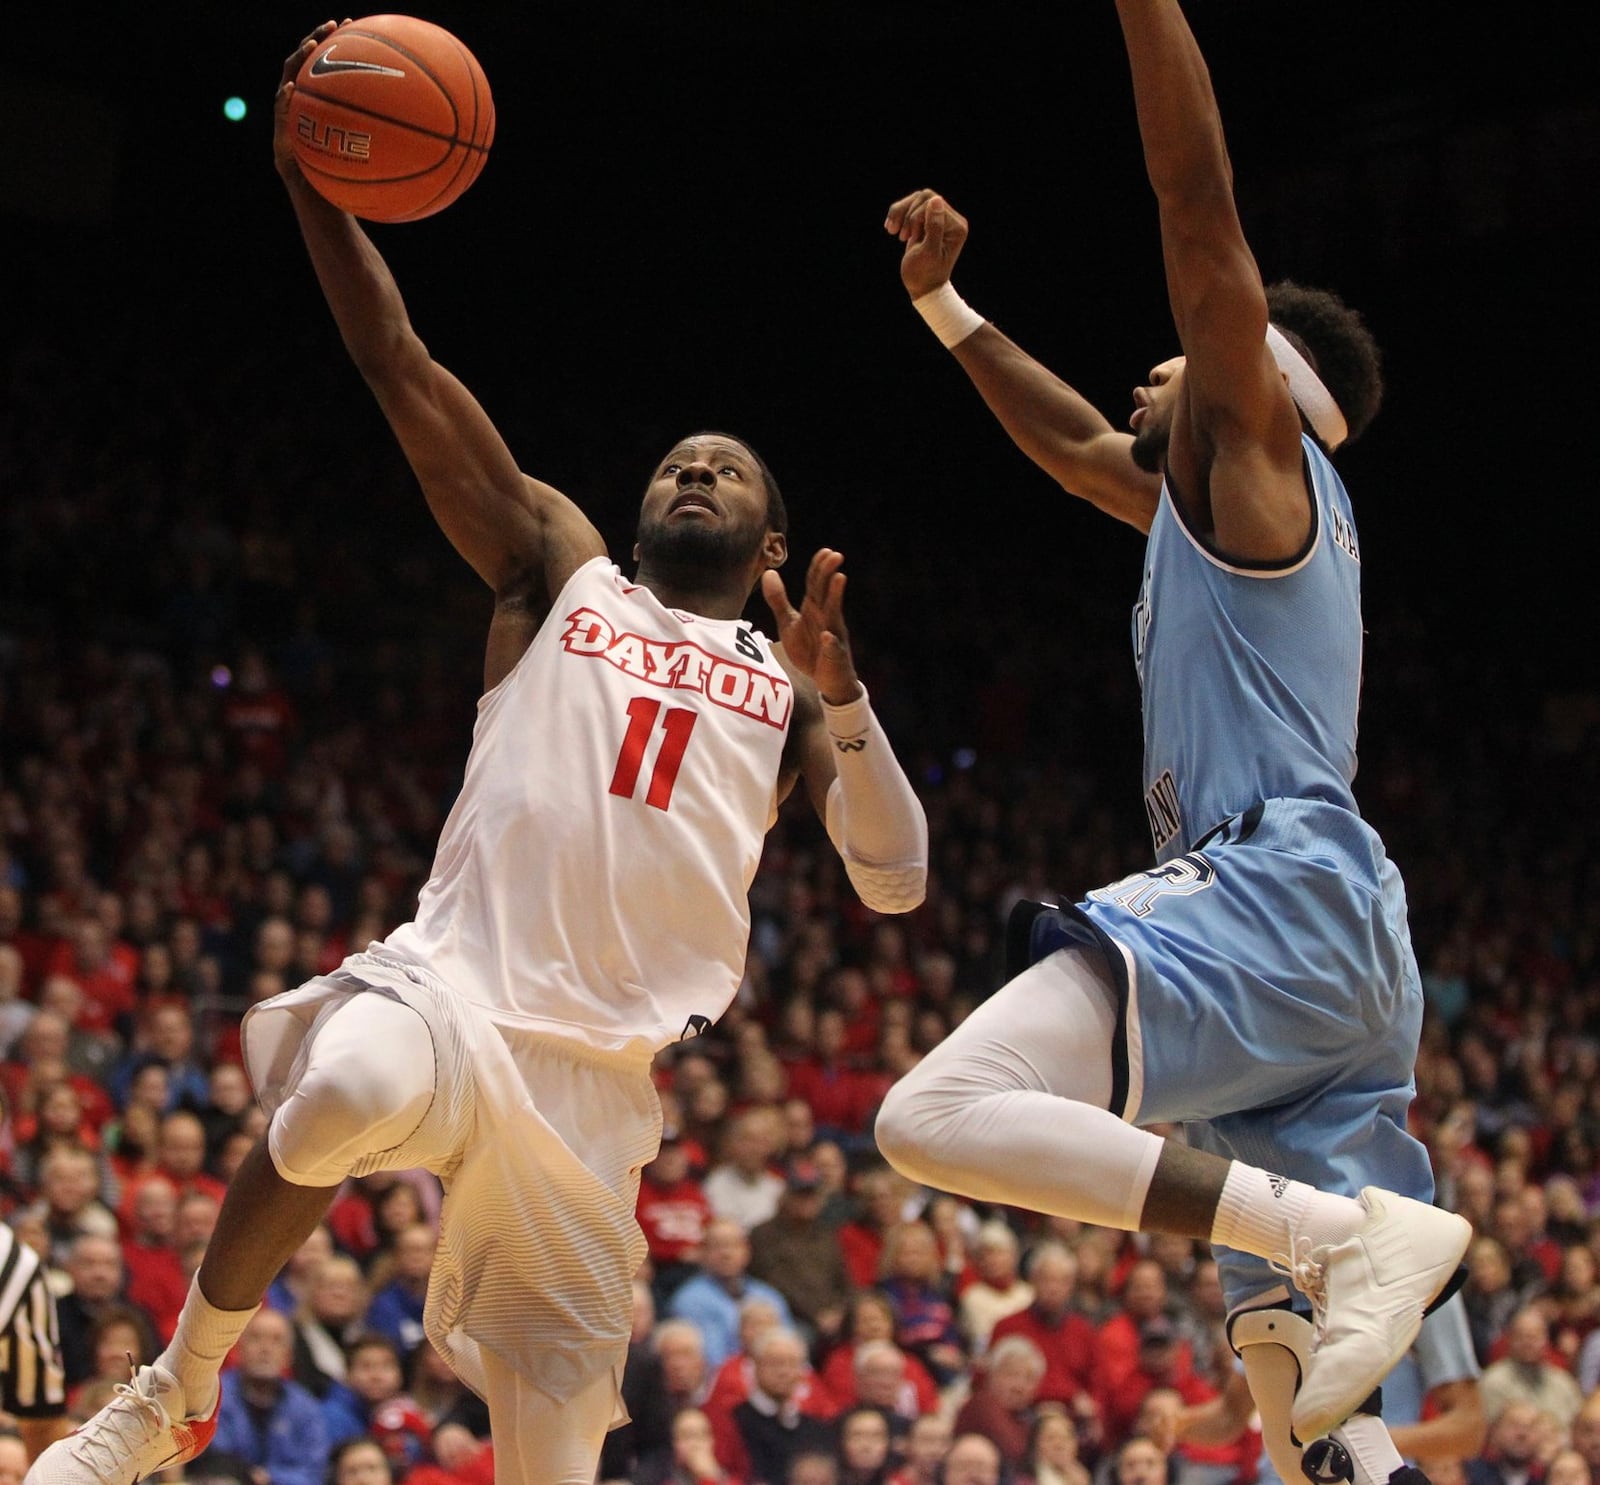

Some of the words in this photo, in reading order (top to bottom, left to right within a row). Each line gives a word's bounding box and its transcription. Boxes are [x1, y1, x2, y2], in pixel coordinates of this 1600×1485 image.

[560, 607, 794, 731] DAYTON
[735, 626, 764, 664] 5
[609, 697, 698, 812] 11
